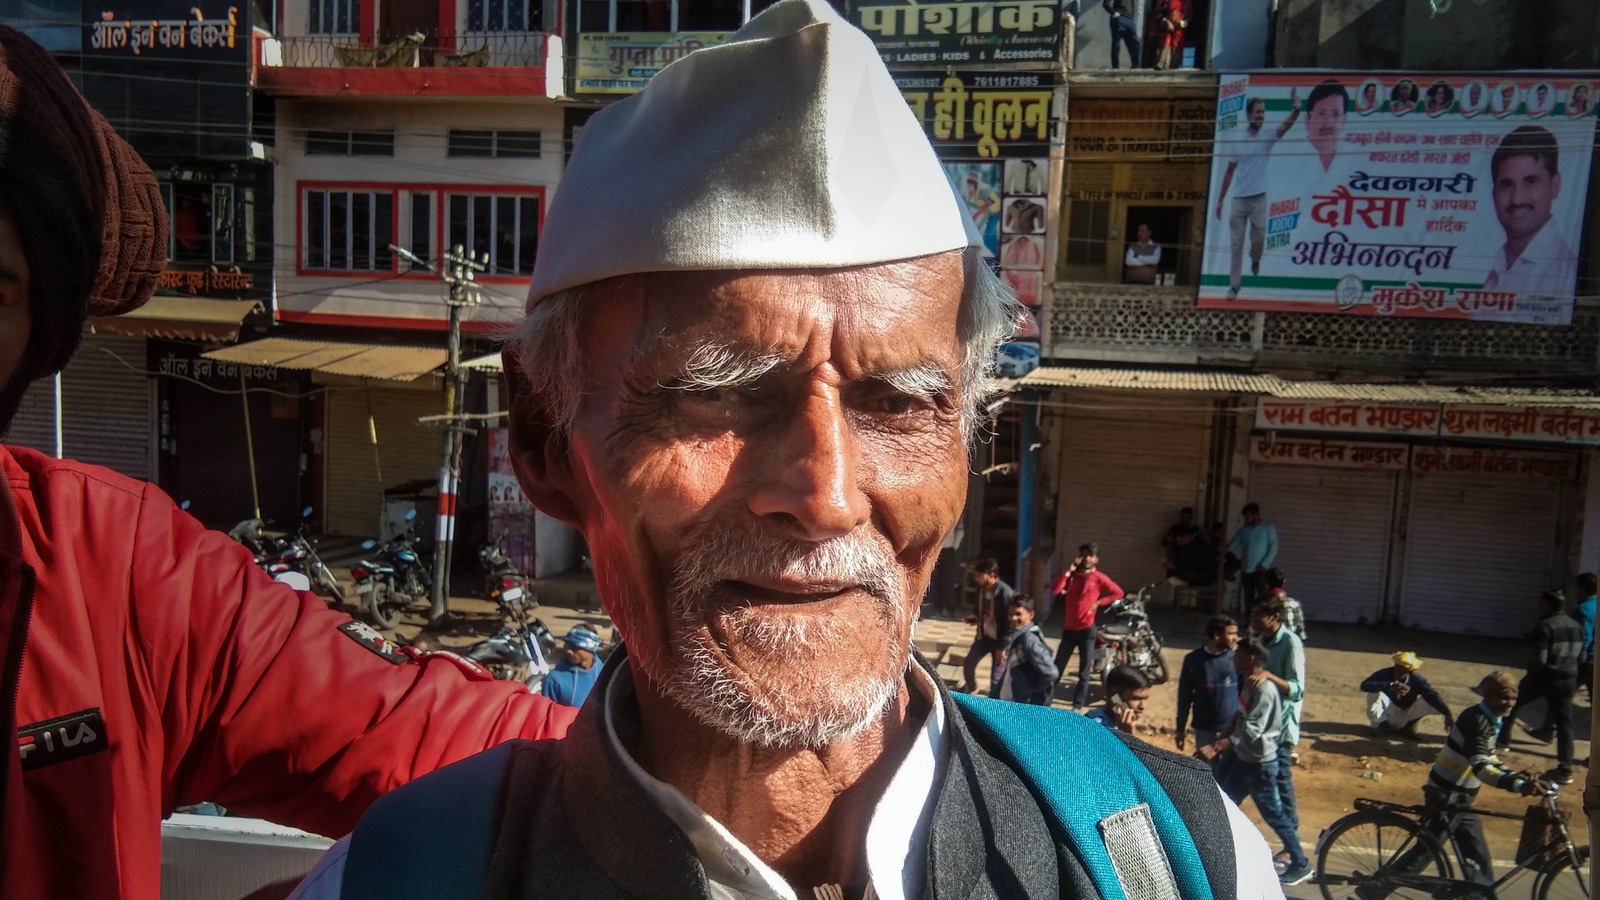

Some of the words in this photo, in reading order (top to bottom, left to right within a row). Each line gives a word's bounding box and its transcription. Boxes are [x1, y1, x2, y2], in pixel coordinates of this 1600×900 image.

[91, 11, 131, 48] ऑल
[131, 20, 158, 54] इन
[158, 19, 188, 48] वन
[858, 0, 1057, 36] पोशाक
[897, 52, 937, 62] LADIES
[942, 51, 970, 61] KIDS
[993, 48, 1053, 60] Accessories
[974, 77, 1039, 87] 7611817885
[933, 77, 968, 141] ही
[972, 91, 1051, 158] वूलन
[1072, 137, 1105, 152] TOUR
[1107, 137, 1119, 152] &
[1121, 137, 1166, 153] TRAVELS
[1348, 171, 1477, 194] देवनगरी
[1311, 186, 1410, 229] दौसा
[1432, 197, 1477, 212] आपका
[1426, 217, 1468, 234] हार्दिक
[1291, 231, 1457, 275] अभिनन्दन
[1372, 283, 1445, 313] मुकेश
[1456, 289, 1516, 312] राणा
[1263, 403, 1307, 425] राम
[1309, 401, 1361, 427] बर्तन
[1364, 406, 1438, 430] भण्डार
[1297, 440, 1347, 461] बर्तन
[1351, 446, 1405, 465] भण्डार
[18, 722, 97, 759] FILA
